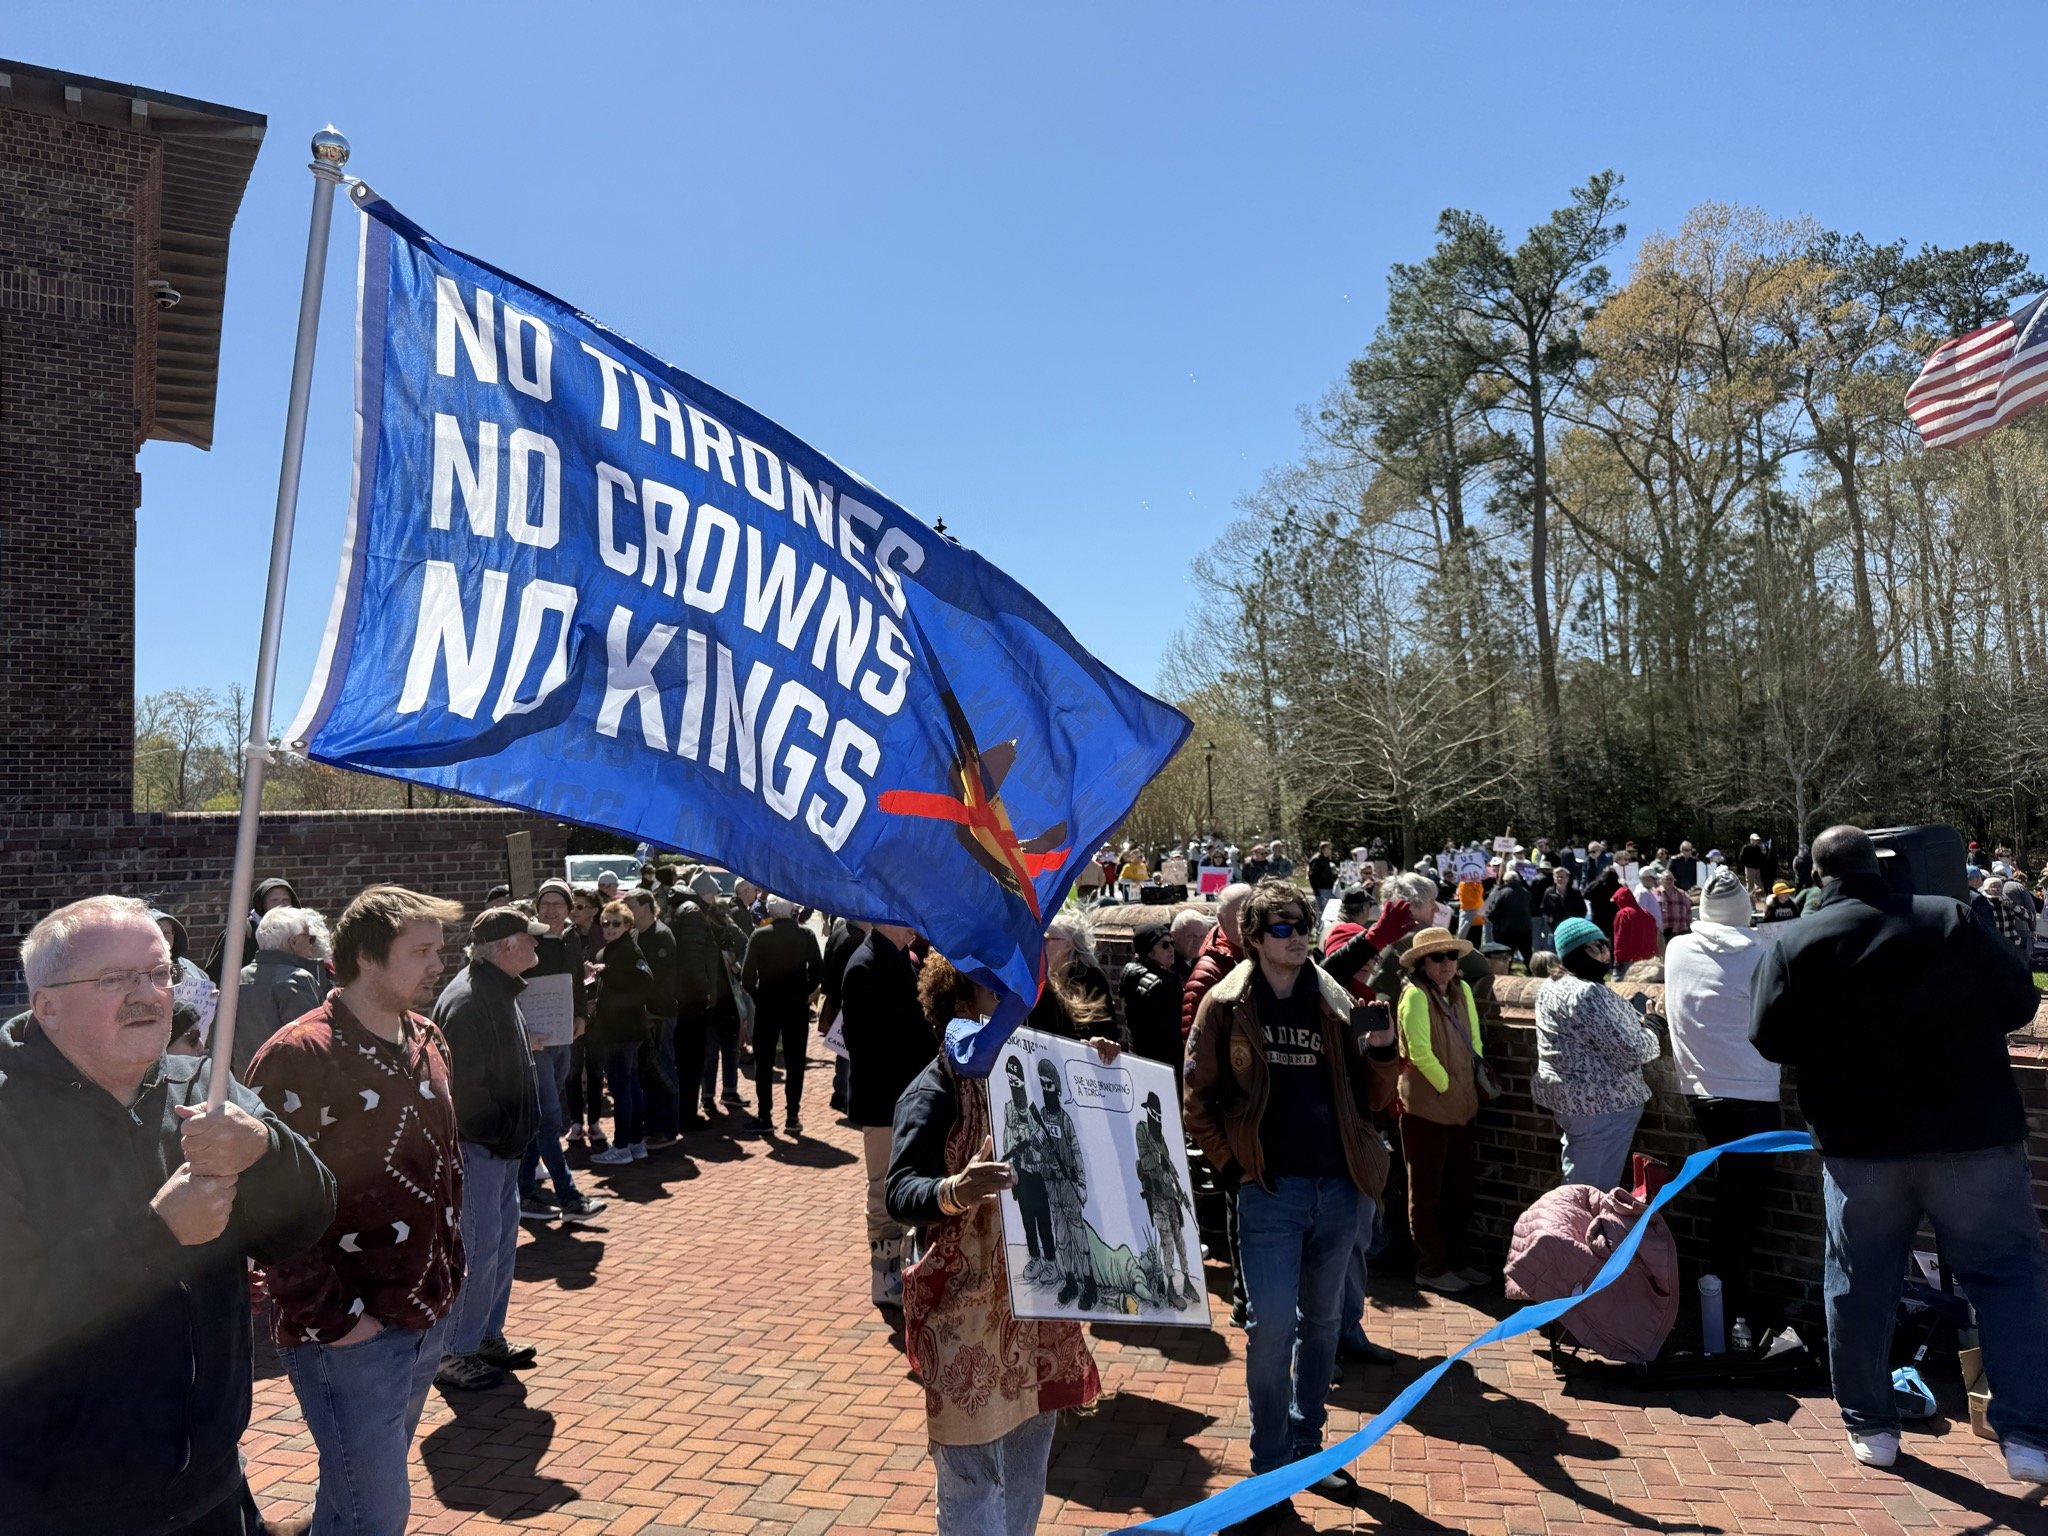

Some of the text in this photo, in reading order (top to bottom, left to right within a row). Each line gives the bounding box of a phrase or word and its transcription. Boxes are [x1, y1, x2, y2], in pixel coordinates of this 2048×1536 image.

[436, 275, 926, 619] NO THRONES
[430, 412, 915, 717] NO CROWNS
[398, 560, 883, 855] NO KINGS
[828, 1037, 846, 1050] CANN
[1278, 1026, 1325, 1055] DIEG
[1007, 1062, 1018, 1073] ICE
[1078, 1085, 1083, 1096] A
[1085, 1078, 1098, 1089] WAS
